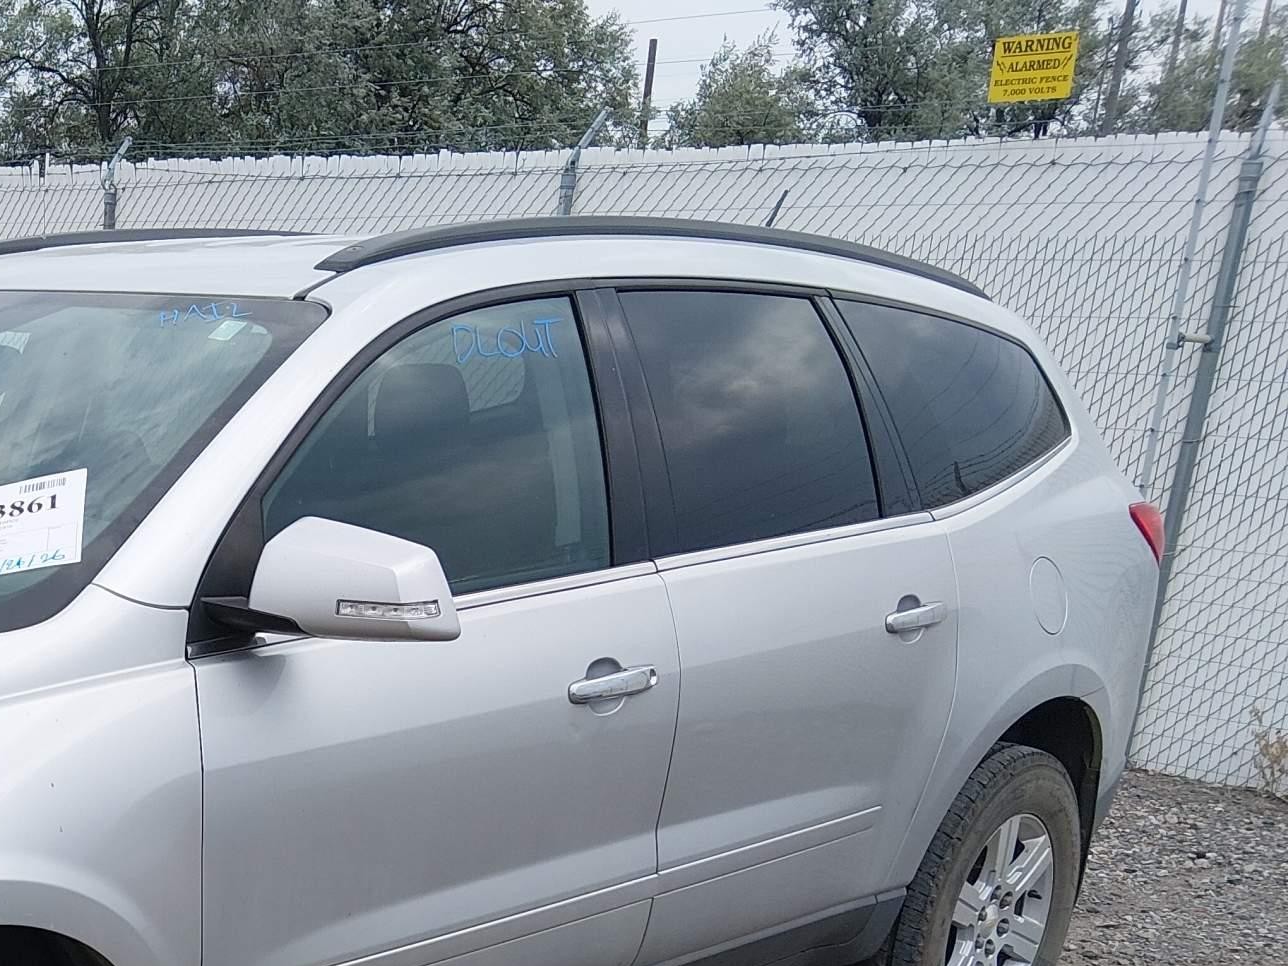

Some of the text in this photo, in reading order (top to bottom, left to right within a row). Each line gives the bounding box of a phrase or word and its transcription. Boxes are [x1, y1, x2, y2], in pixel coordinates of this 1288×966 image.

[1002, 36, 1073, 55] WARNING
[1007, 58, 1061, 73] ALARMED
[993, 74, 1069, 87] ELECTRIC FENCE
[1028, 86, 1057, 95] VOLTS
